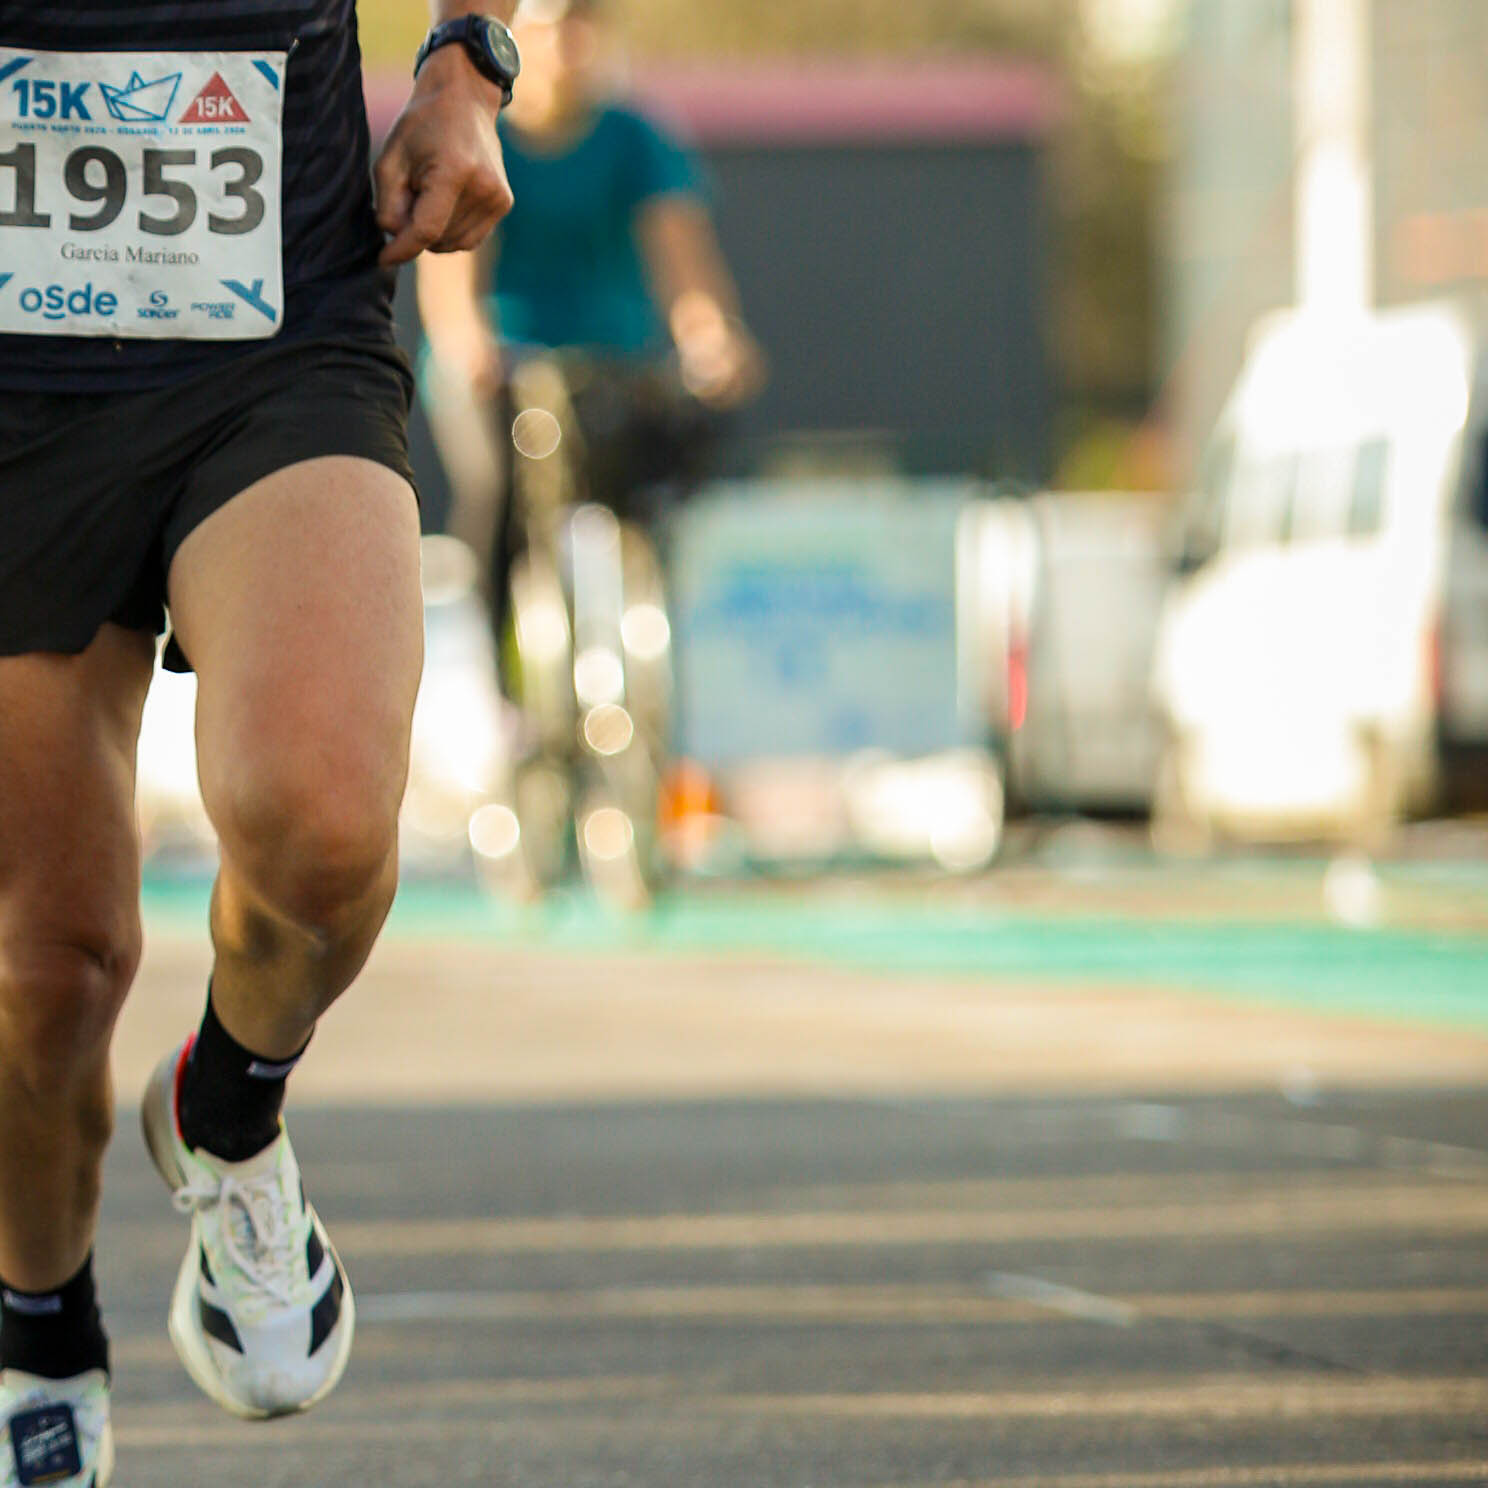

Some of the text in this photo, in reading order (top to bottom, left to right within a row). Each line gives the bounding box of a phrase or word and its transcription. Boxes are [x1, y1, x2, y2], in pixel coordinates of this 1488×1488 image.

[12, 79, 92, 120] 15K
[195, 96, 234, 118] 15K
[125, 245, 199, 265] Mariano
[19, 282, 118, 319] osde
